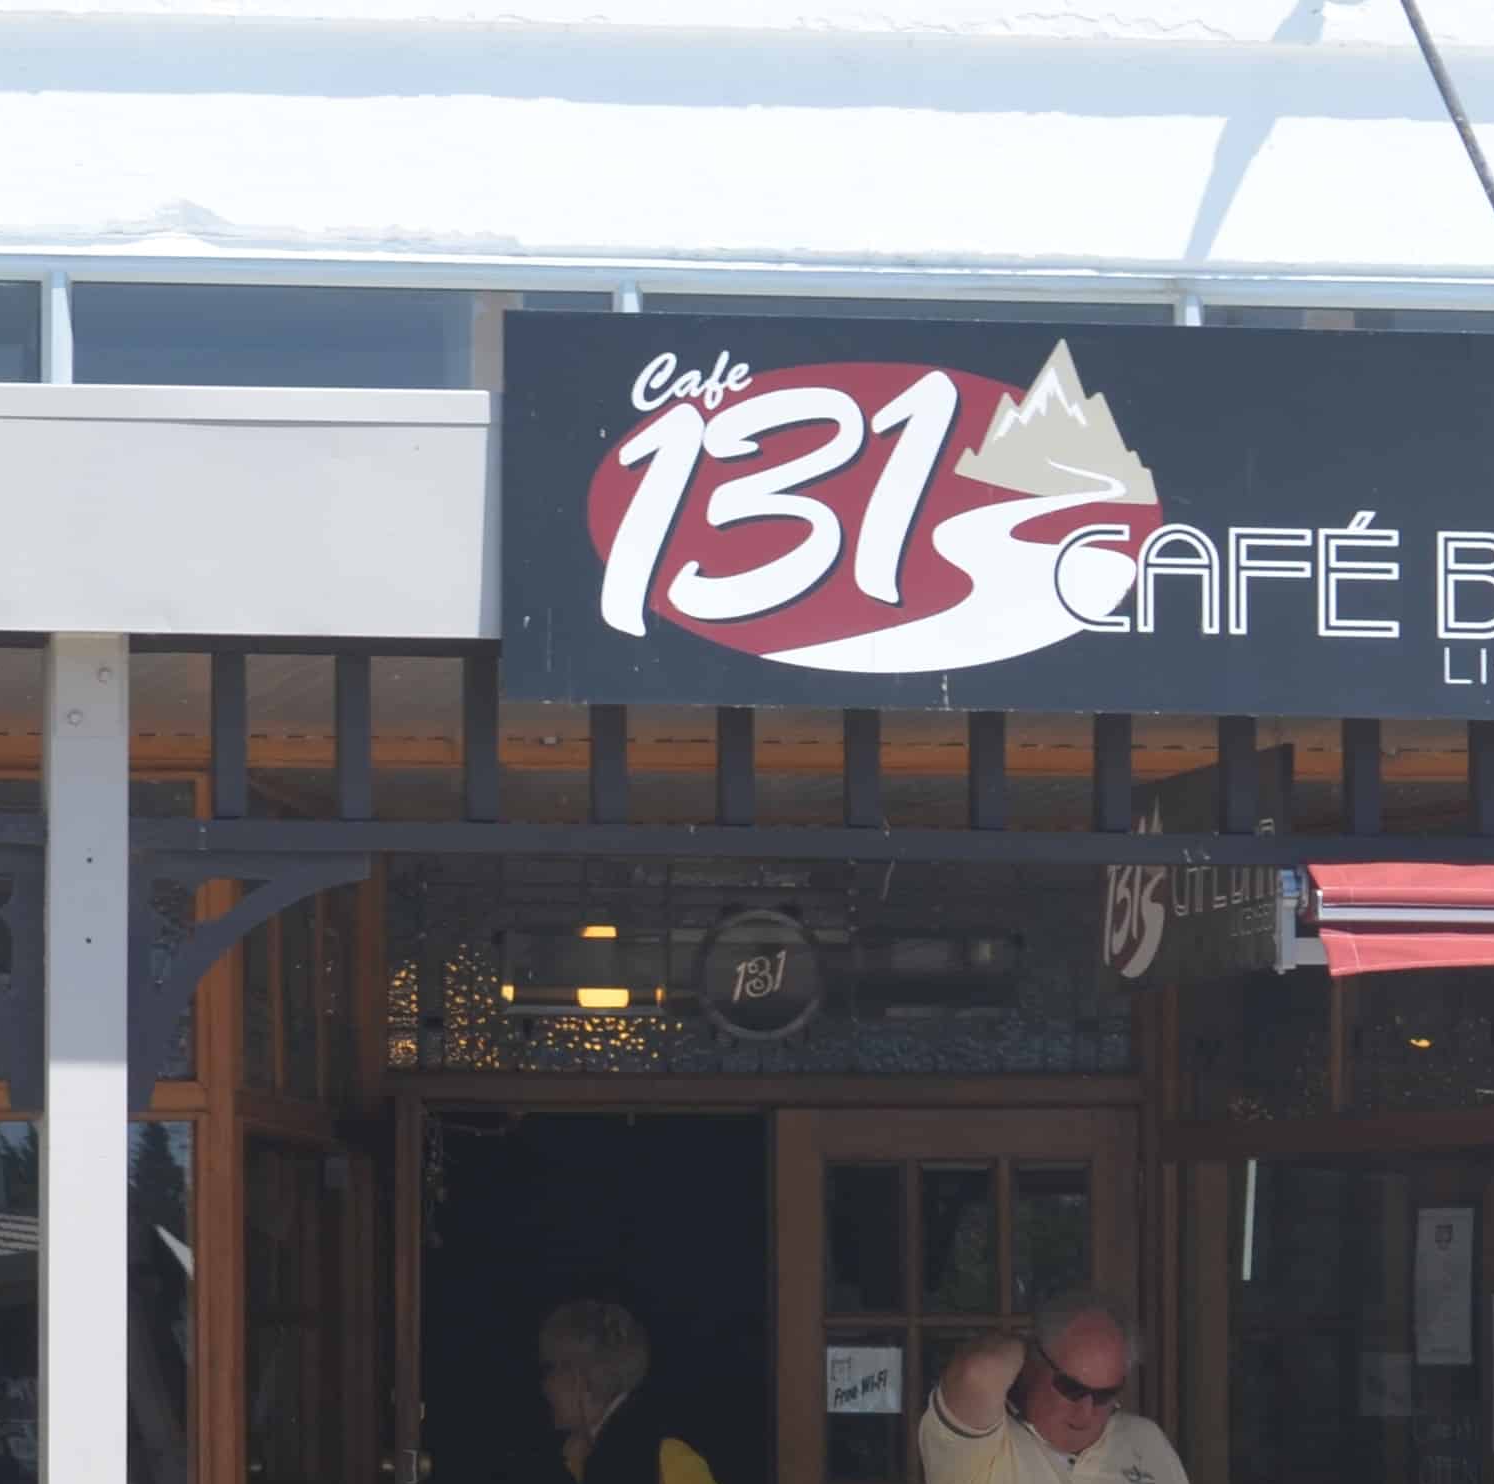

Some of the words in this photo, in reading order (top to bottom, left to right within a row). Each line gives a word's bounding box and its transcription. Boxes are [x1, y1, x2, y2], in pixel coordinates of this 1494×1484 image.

[631, 350, 753, 411] Cafe
[600, 369, 960, 638] 131
[1054, 510, 1400, 638] CAFÉ
[732, 949, 788, 1003] 131
